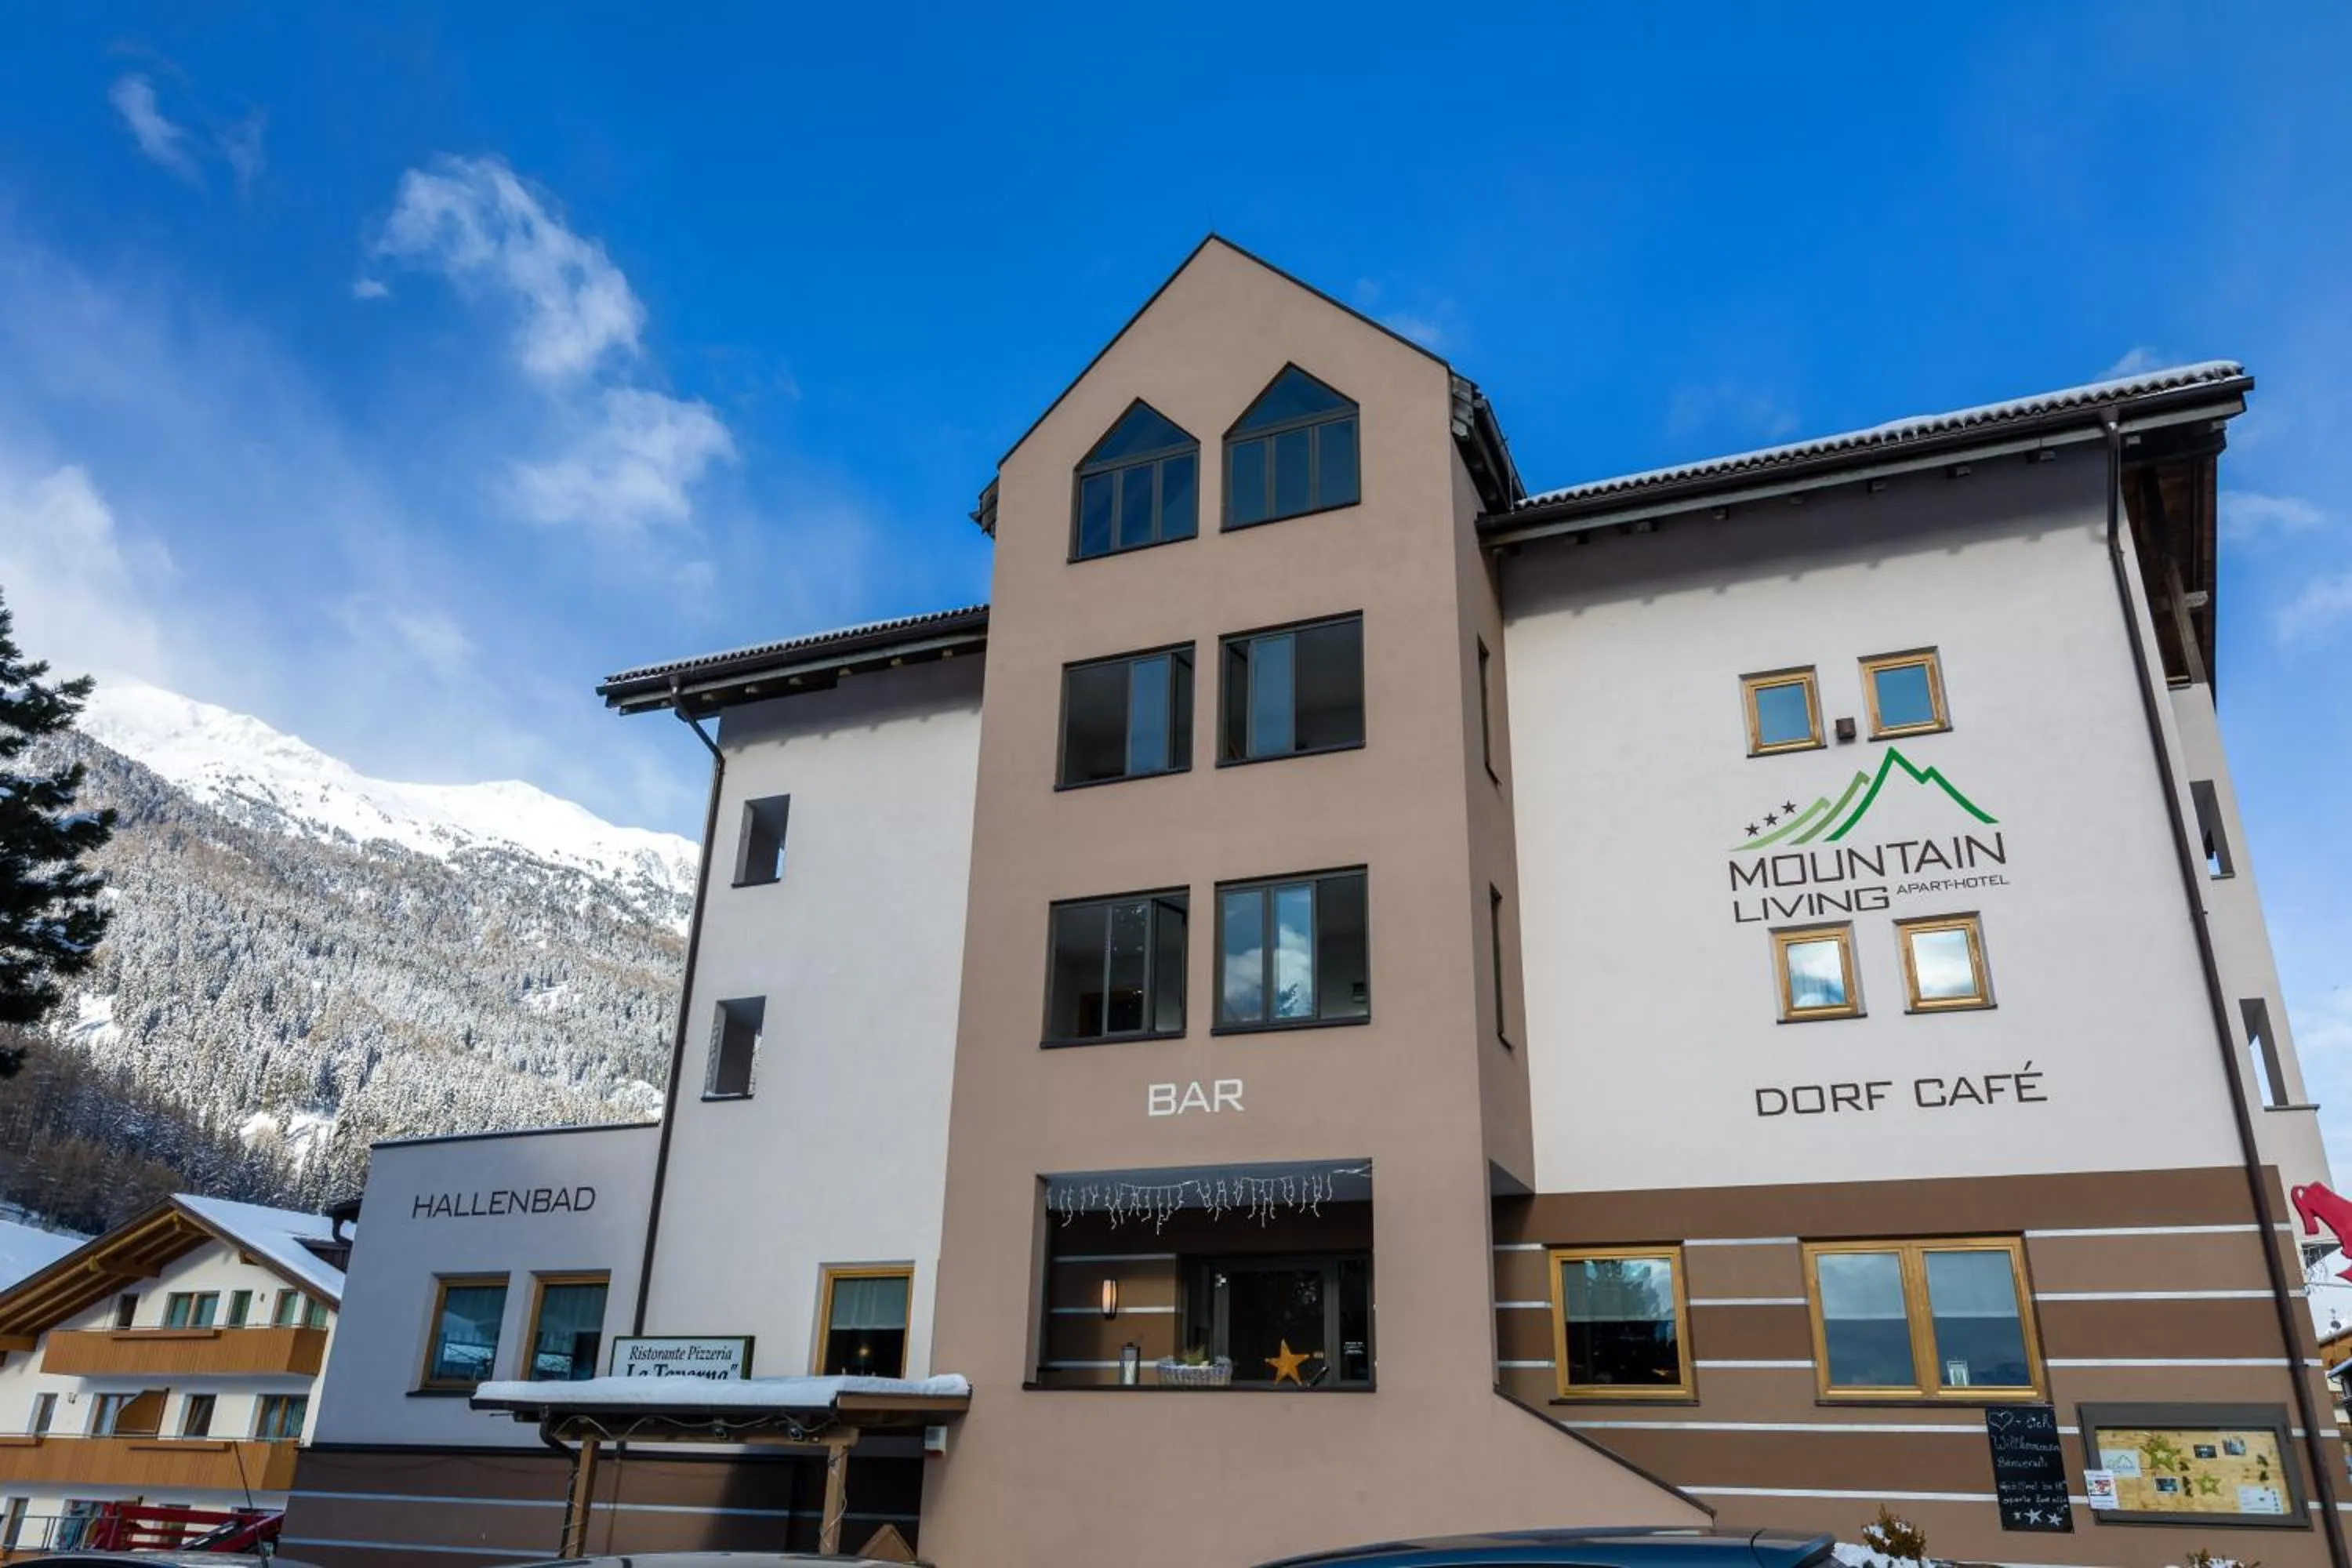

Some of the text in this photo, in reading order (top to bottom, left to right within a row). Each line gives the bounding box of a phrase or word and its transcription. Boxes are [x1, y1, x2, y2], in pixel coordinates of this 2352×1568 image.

[1729, 832, 2006, 891] MOUNTAIN
[1896, 874, 2010, 895] APART-HOTEL
[1733, 886, 1889, 923] LIVING
[1148, 1079, 1244, 1116] BAR
[1755, 1061, 2048, 1116] DORF CAFÉ
[412, 1186, 596, 1219] HALLENBAD
[630, 1345, 733, 1360] Ristorante Pizzeria
